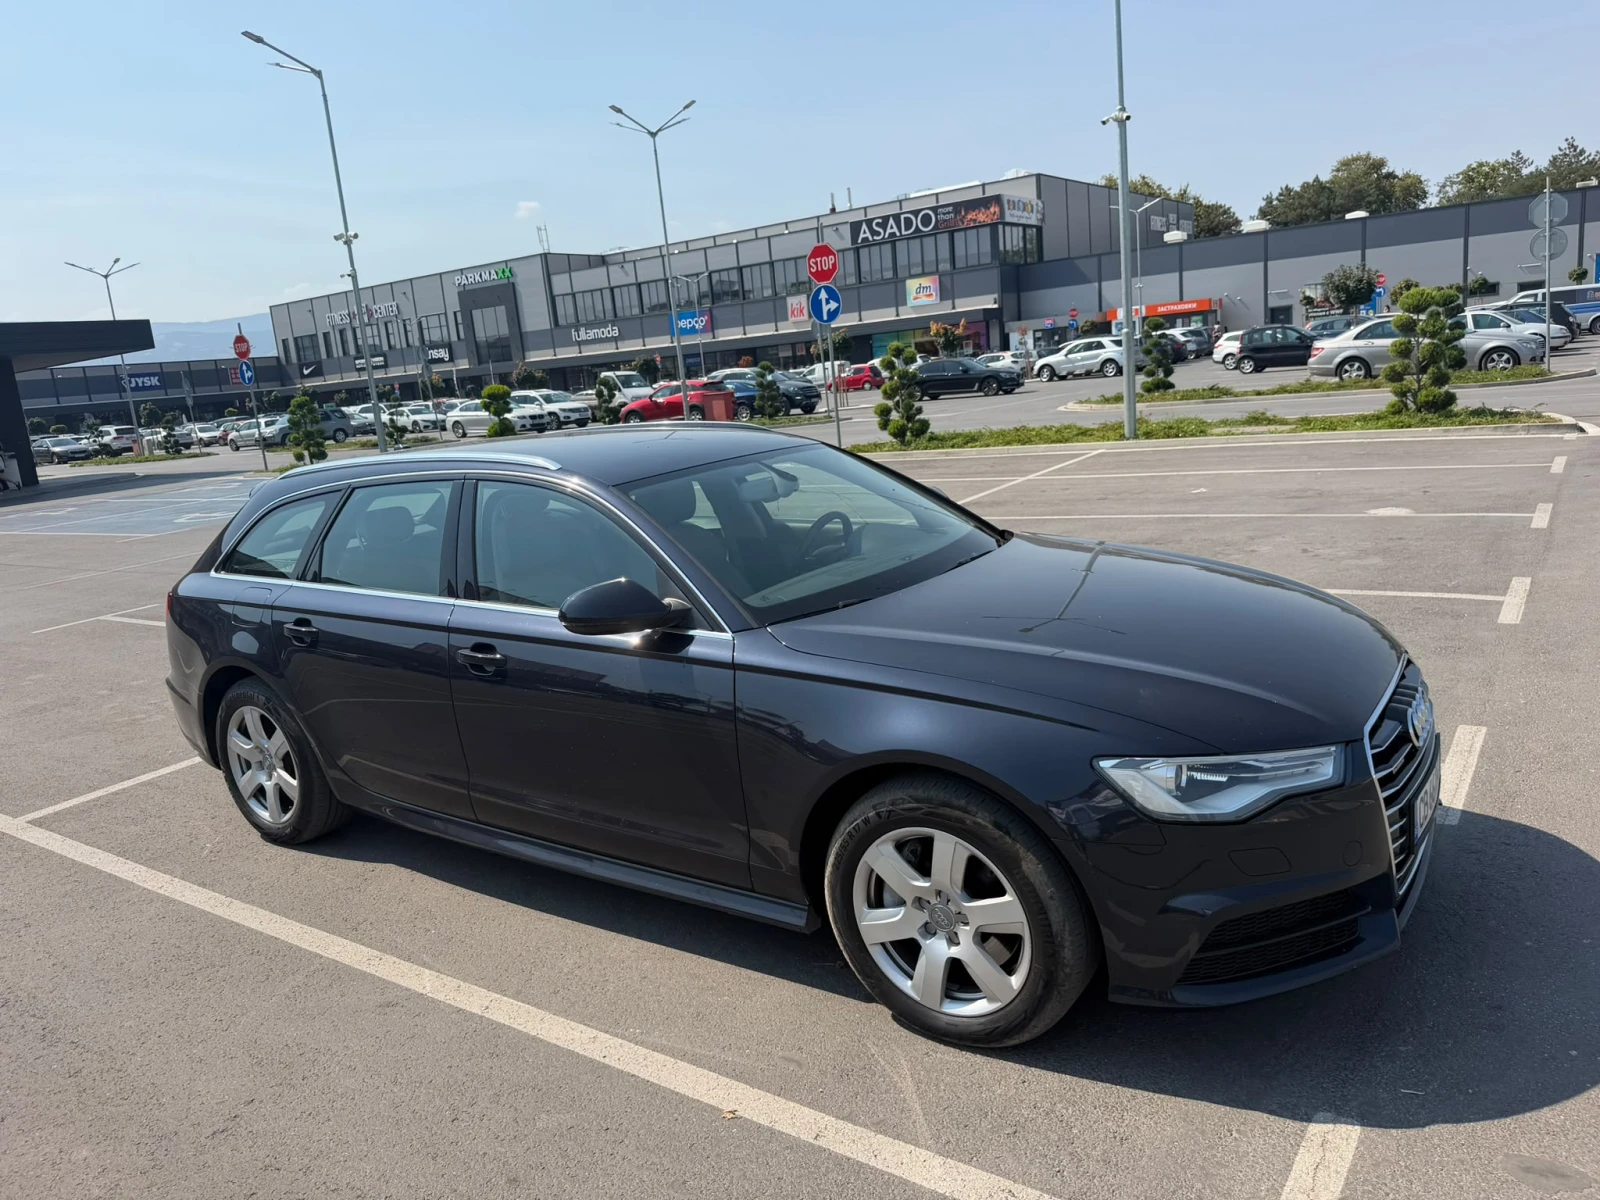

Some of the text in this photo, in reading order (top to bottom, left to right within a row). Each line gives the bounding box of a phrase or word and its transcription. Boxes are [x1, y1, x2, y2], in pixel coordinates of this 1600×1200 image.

[937, 206, 953, 214] more
[937, 213, 954, 221] than
[857, 209, 936, 244] ASADO
[809, 255, 835, 273] STOP
[454, 266, 512, 287] PARKMAXX
[915, 283, 932, 295] dm
[325, 309, 351, 327] FITNESS
[372, 301, 399, 319] CENTER
[571, 323, 619, 341] fullamoda
[235, 343, 248, 353] STOP
[130, 376, 161, 388] JYSK
